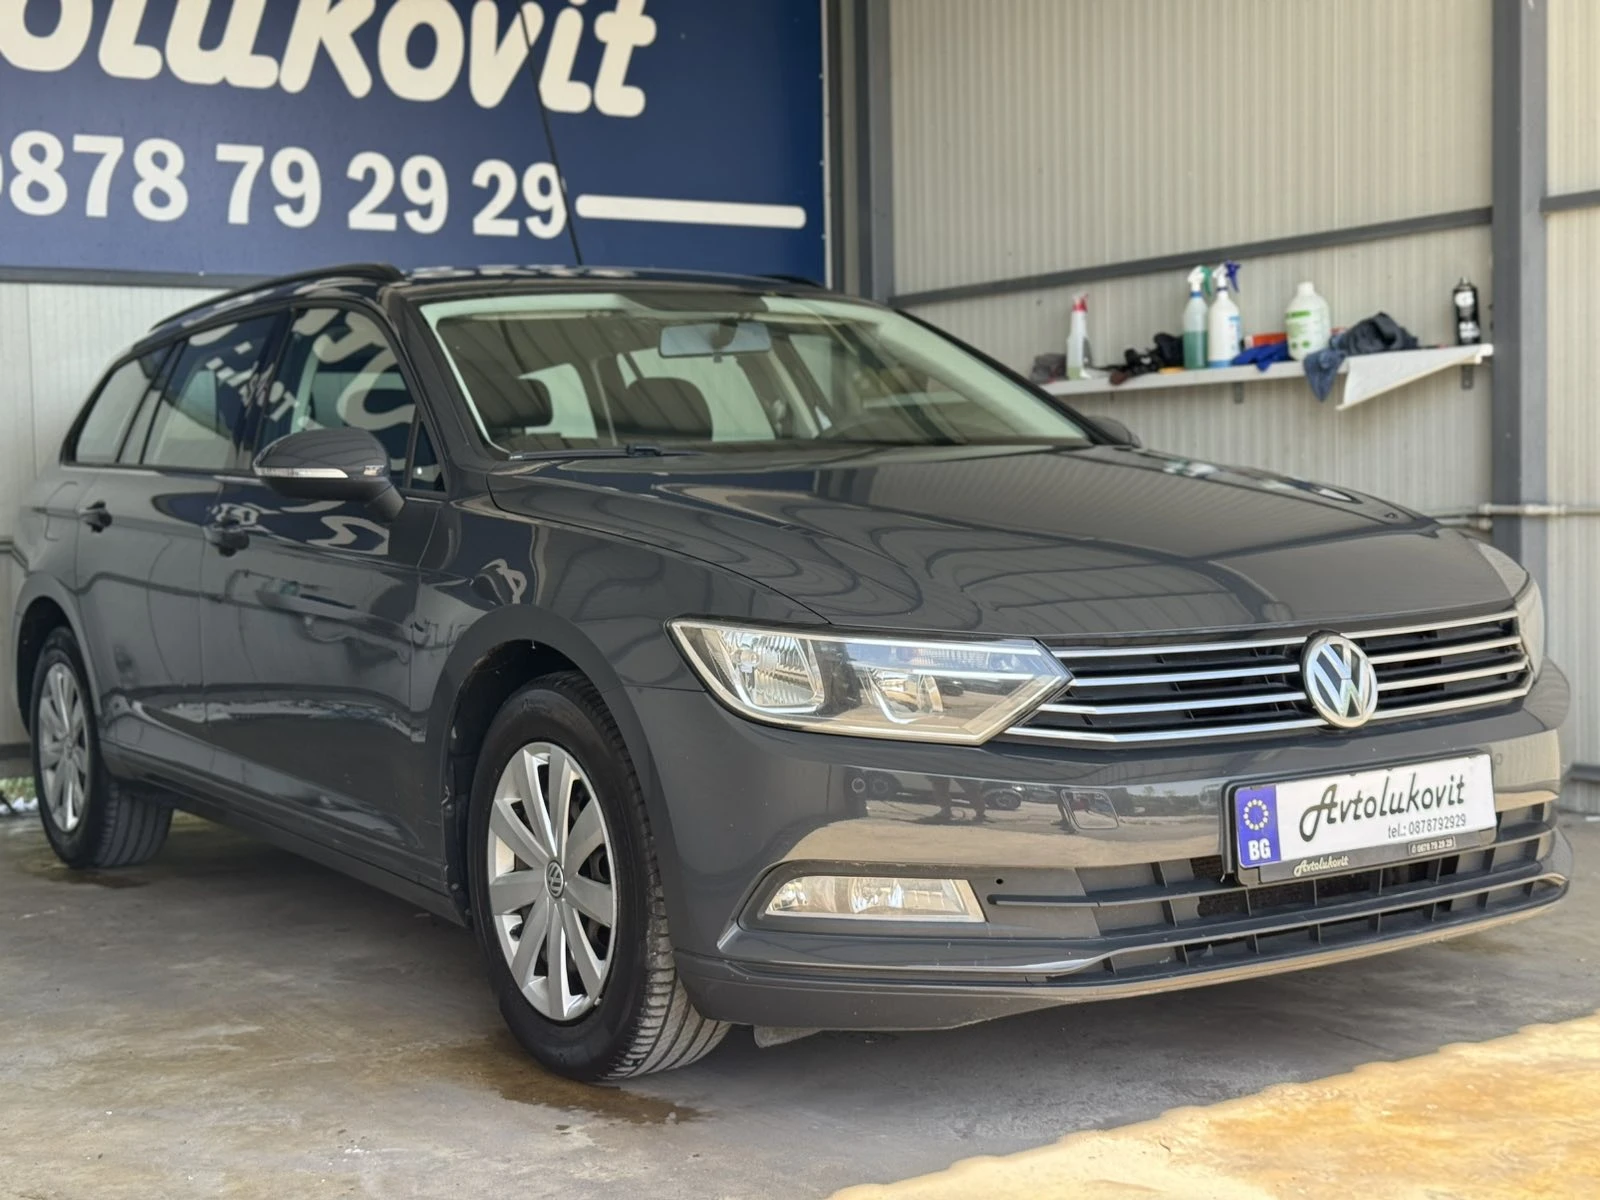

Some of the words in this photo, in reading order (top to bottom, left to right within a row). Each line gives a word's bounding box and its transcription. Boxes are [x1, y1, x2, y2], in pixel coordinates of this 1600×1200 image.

[0, 130, 188, 222] 878
[216, 143, 321, 228] 79
[347, 152, 449, 234] 29
[472, 159, 567, 239] 29
[1299, 772, 1466, 842] Avtolukovit
[1408, 813, 1467, 836] 0878792929
[1248, 838, 1272, 861] BG
